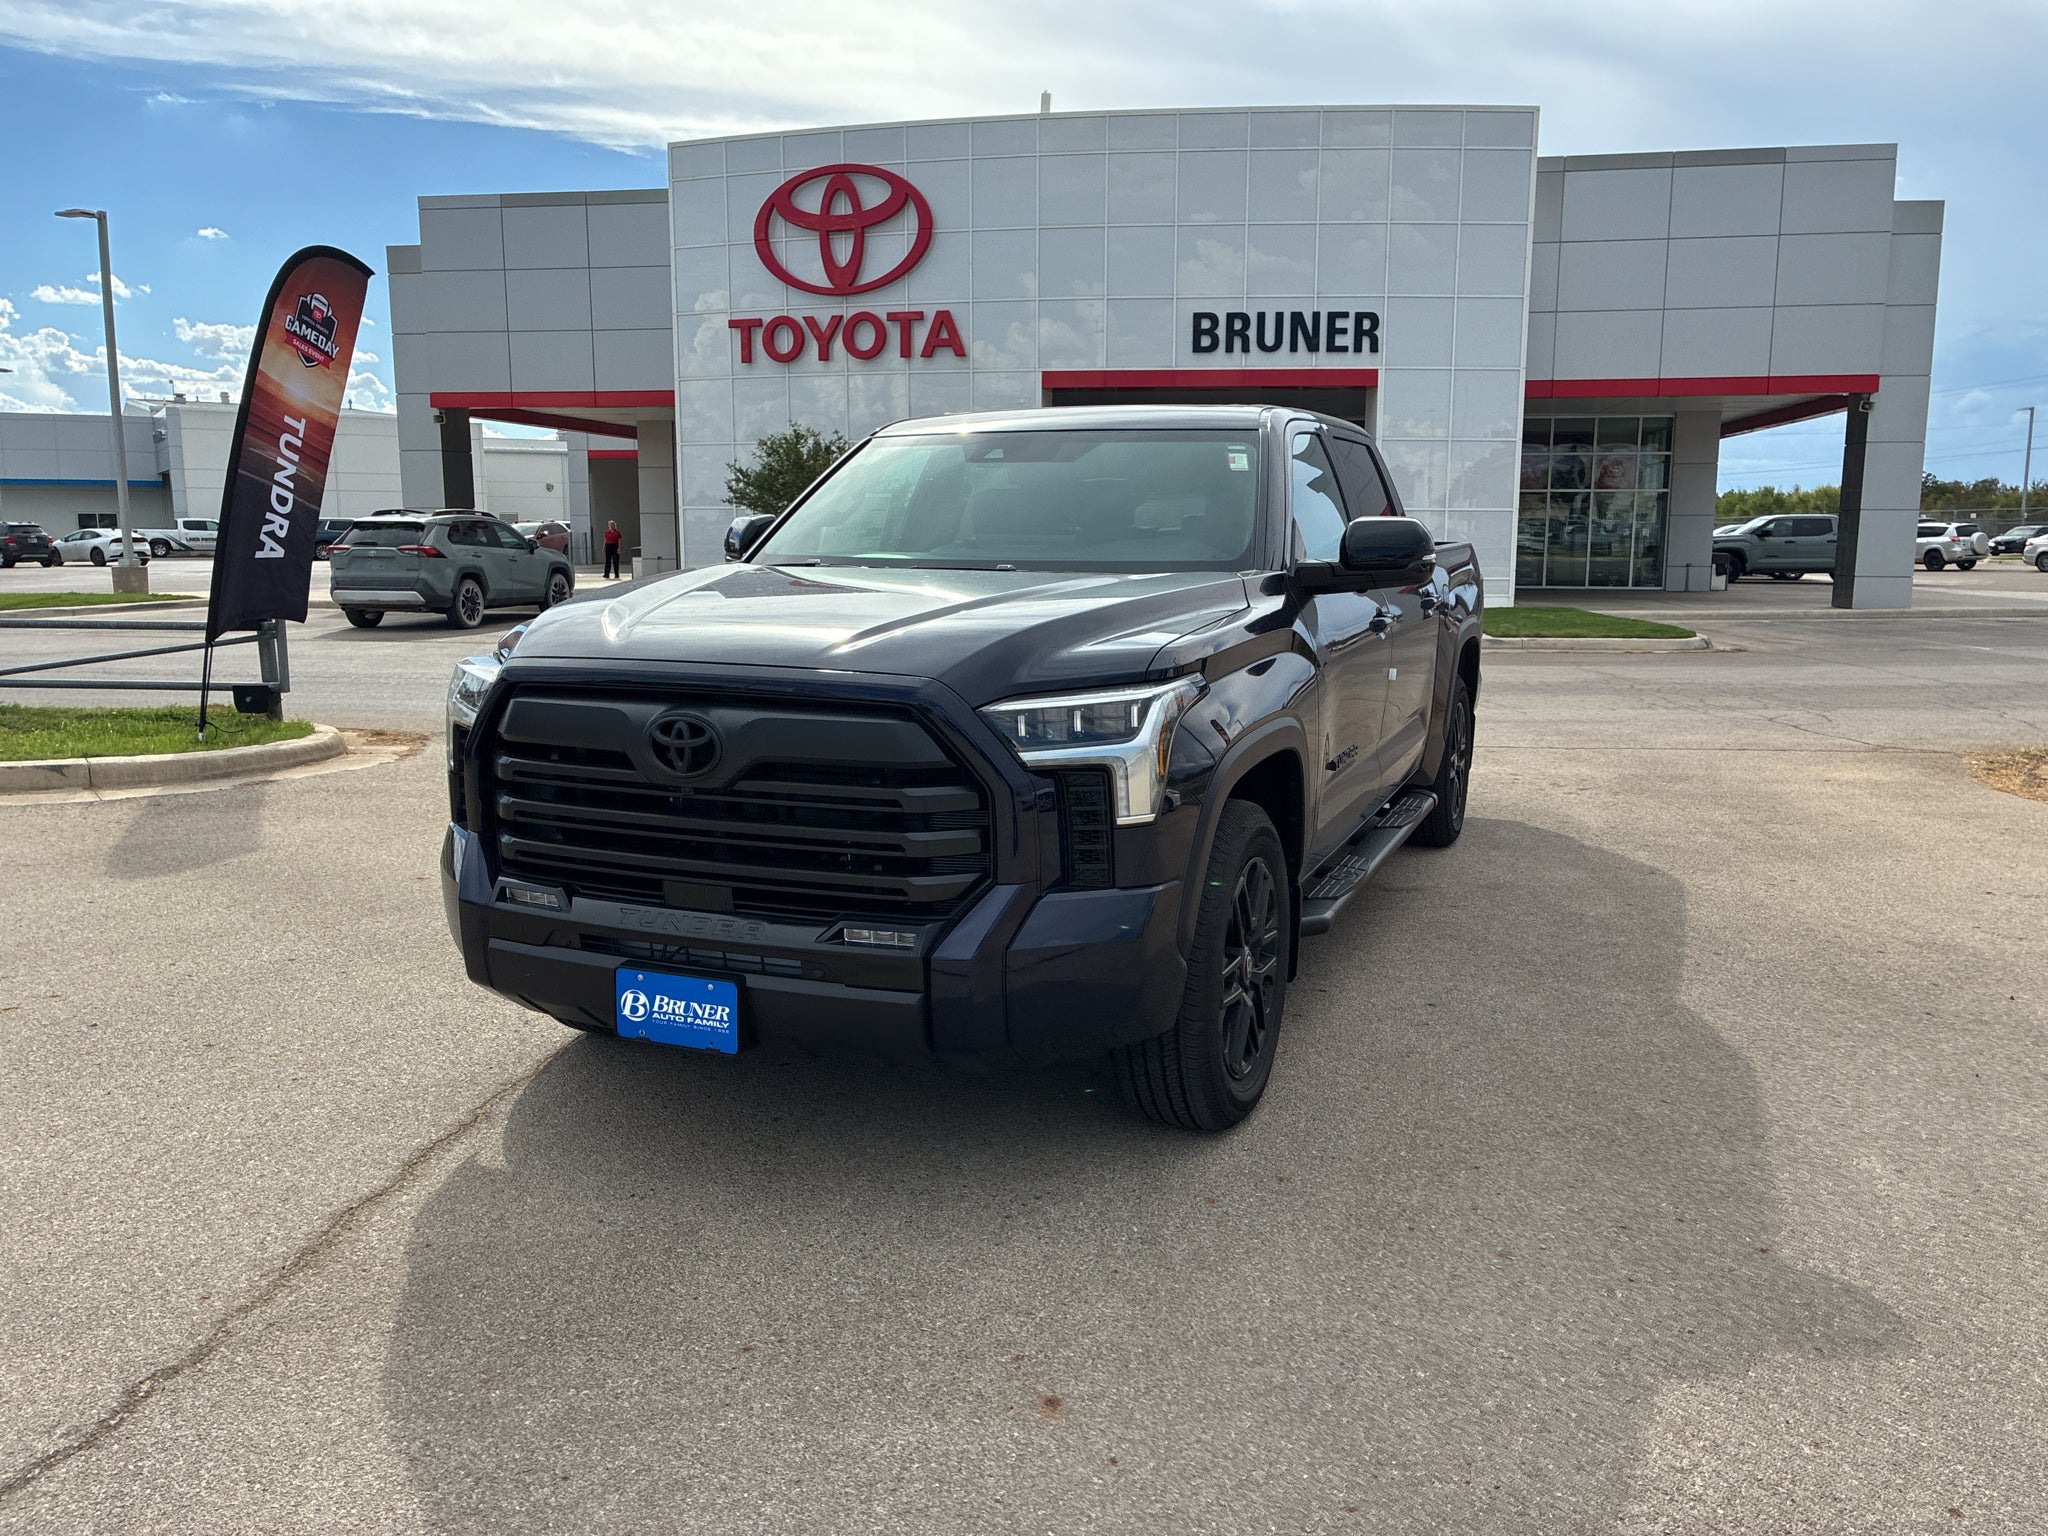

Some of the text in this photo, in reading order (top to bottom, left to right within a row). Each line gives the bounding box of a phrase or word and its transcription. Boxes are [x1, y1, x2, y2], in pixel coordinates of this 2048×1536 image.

[285, 314, 340, 358] GAMEDAY
[292, 338, 325, 362] SALES EVENT
[728, 310, 967, 364] TOYOTA
[1192, 311, 1380, 353] BRUNER
[254, 415, 306, 559] TUNDRA
[619, 907, 766, 941] TUNDRA
[652, 994, 730, 1021] BRUNER
[652, 1012, 730, 1029] AUTO FAMILY
